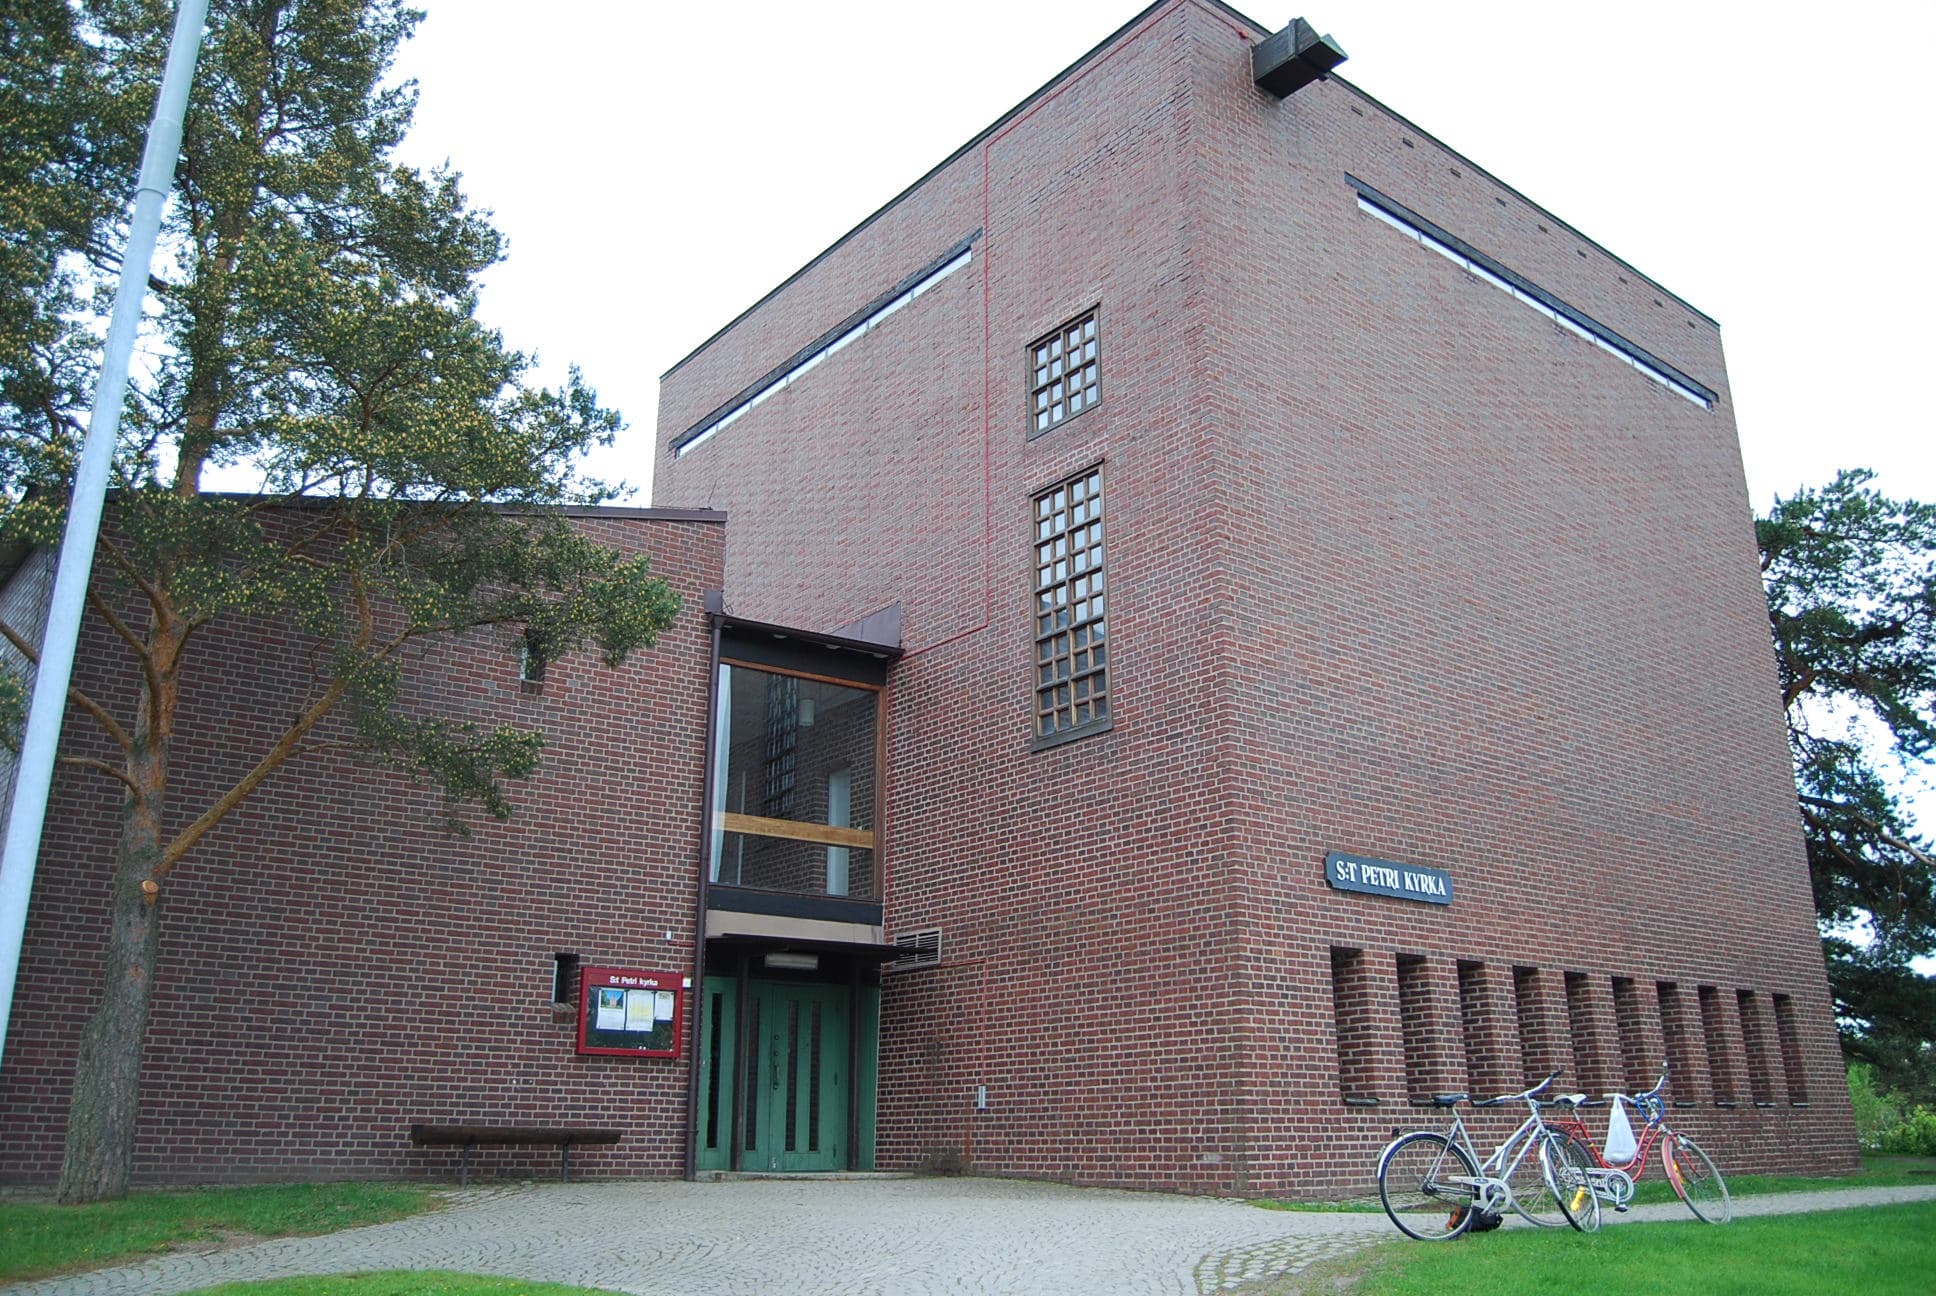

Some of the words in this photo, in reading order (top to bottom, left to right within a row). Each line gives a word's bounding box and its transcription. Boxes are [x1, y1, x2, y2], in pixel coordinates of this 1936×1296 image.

[1336, 860, 1358, 882] S:T
[1360, 864, 1400, 890] PETRI
[1403, 871, 1447, 896] KYRKA
[621, 976, 637, 985] Petri
[639, 978, 658, 987] kyrka
